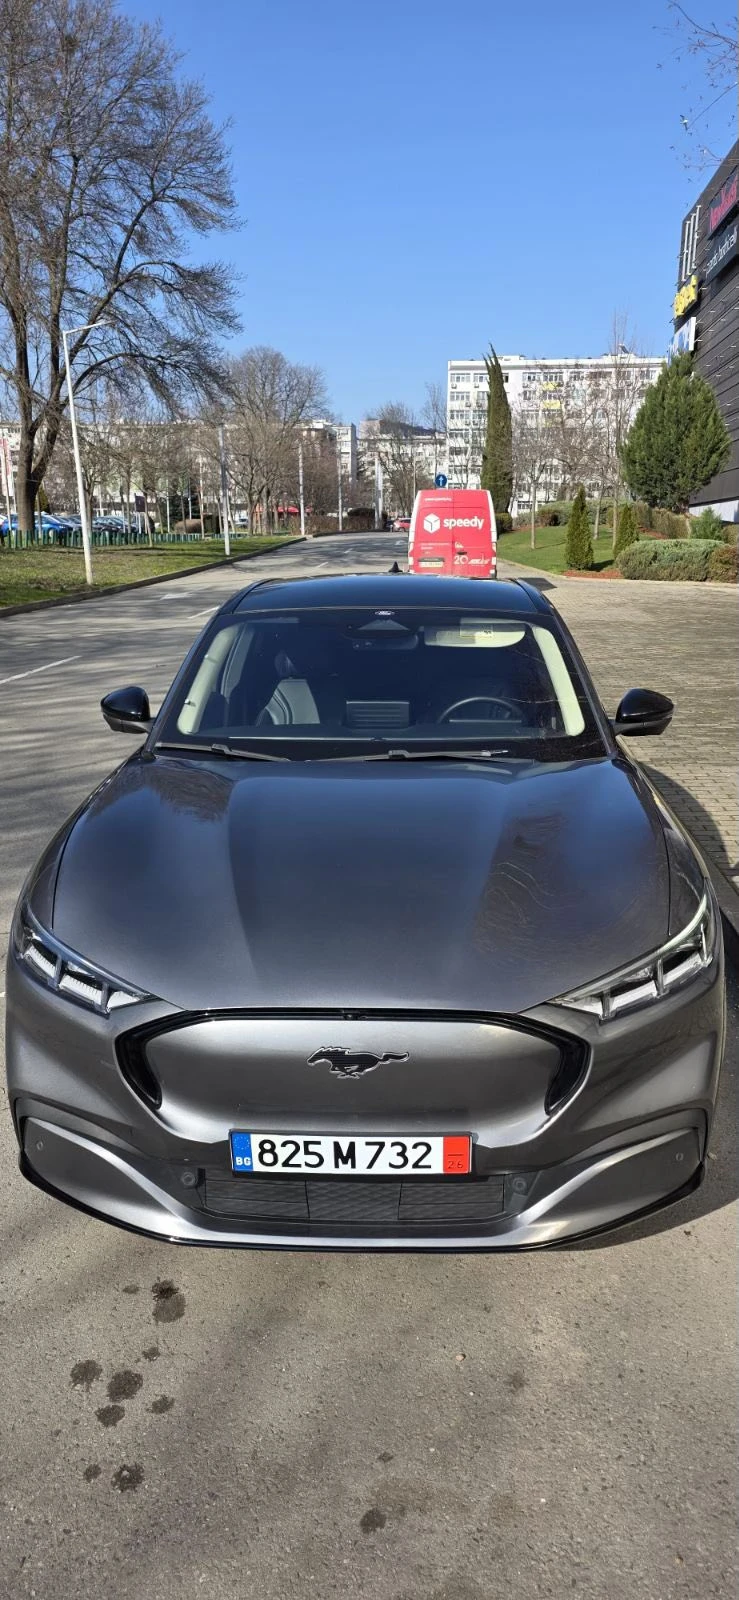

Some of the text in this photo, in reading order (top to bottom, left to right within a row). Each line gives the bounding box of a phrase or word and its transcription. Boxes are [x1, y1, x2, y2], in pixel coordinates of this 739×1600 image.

[443, 515, 485, 530] speedy
[257, 1138, 432, 1169] 825 M 732
[235, 1156, 252, 1166] BG
[447, 1159, 464, 1170] 26
